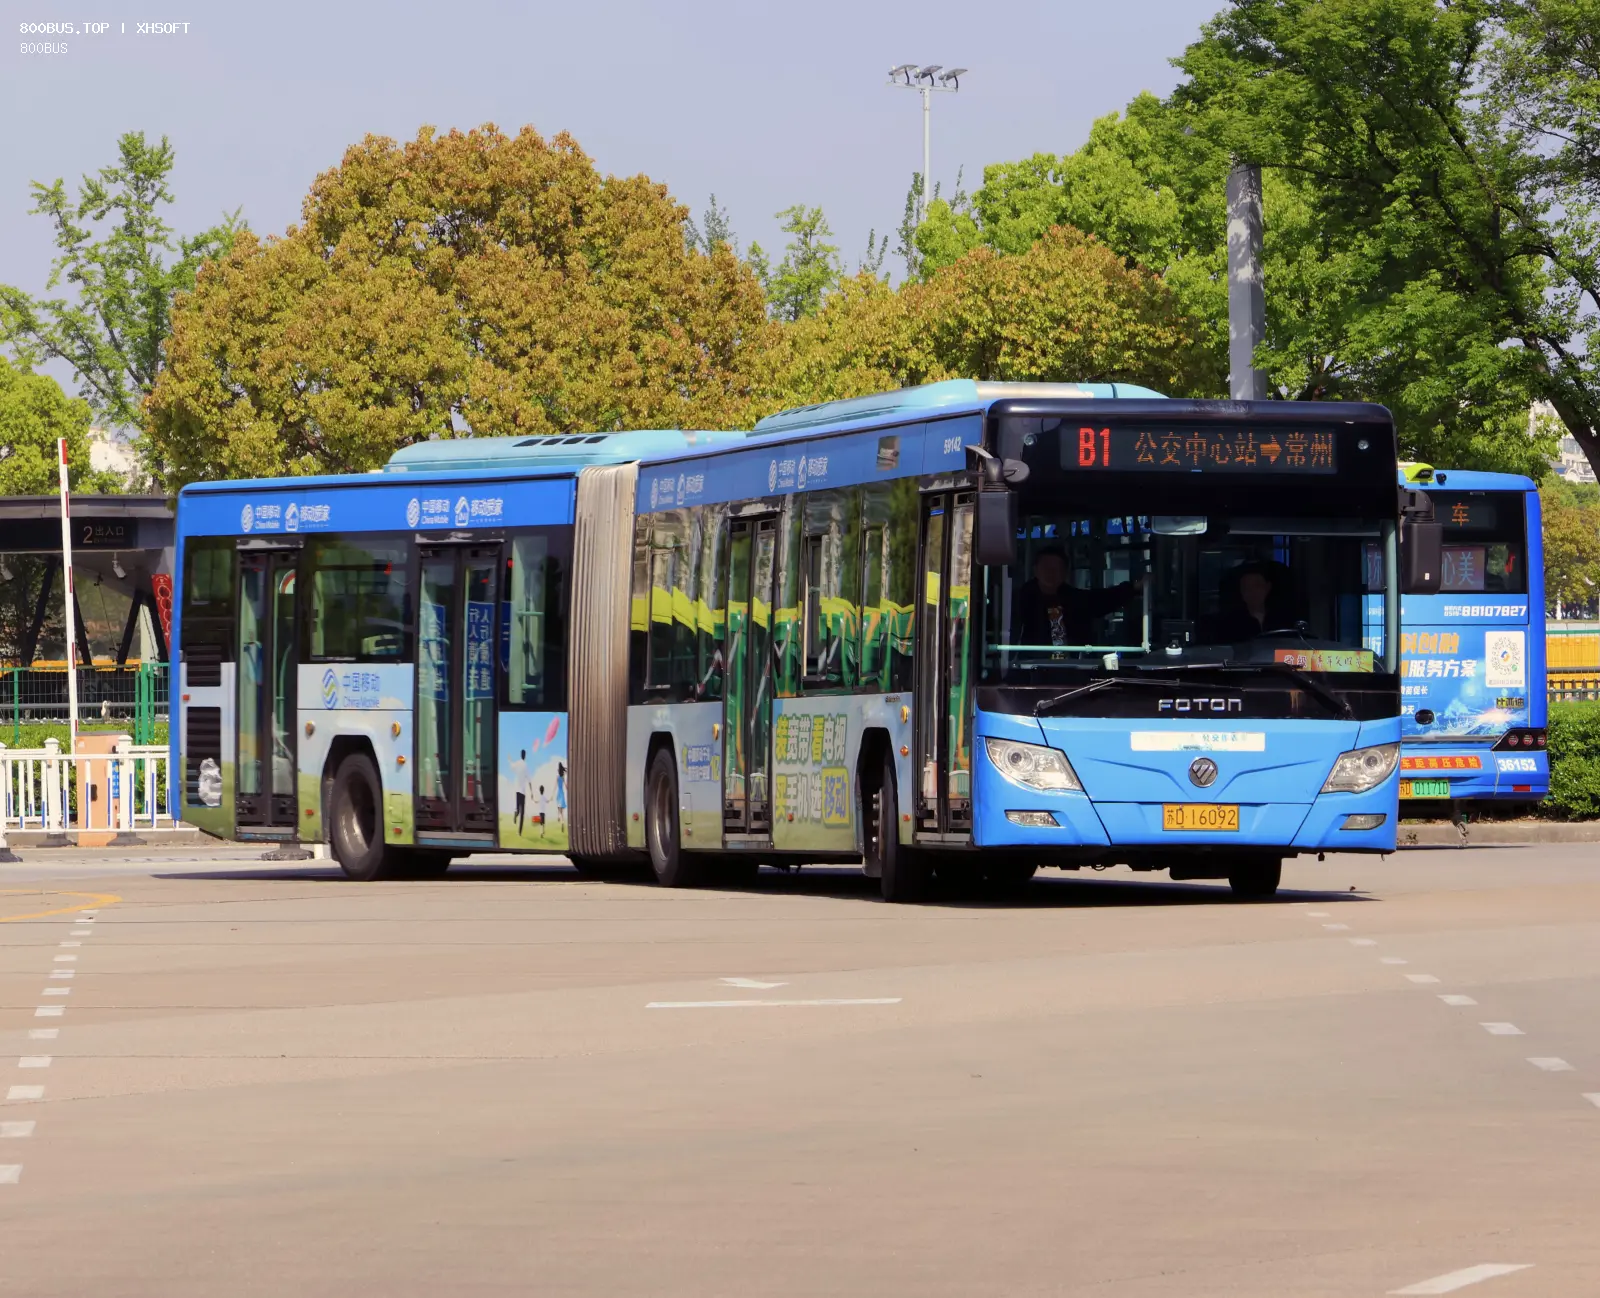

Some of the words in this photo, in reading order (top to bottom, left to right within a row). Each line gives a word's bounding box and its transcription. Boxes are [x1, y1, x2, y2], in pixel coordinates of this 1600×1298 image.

[943, 436, 961, 455] 59142
[1078, 427, 1110, 467] B1
[1135, 431, 1258, 467] 公交中心站
[1285, 431, 1333, 467] 常州
[1452, 502, 1470, 527] 车
[83, 525, 93, 544] 2
[95, 525, 124, 536] 出入口
[1461, 605, 1527, 617] 88107827
[343, 672, 380, 692] 中国移动
[1158, 698, 1242, 712] FOTON
[1498, 757, 1538, 772] 36152
